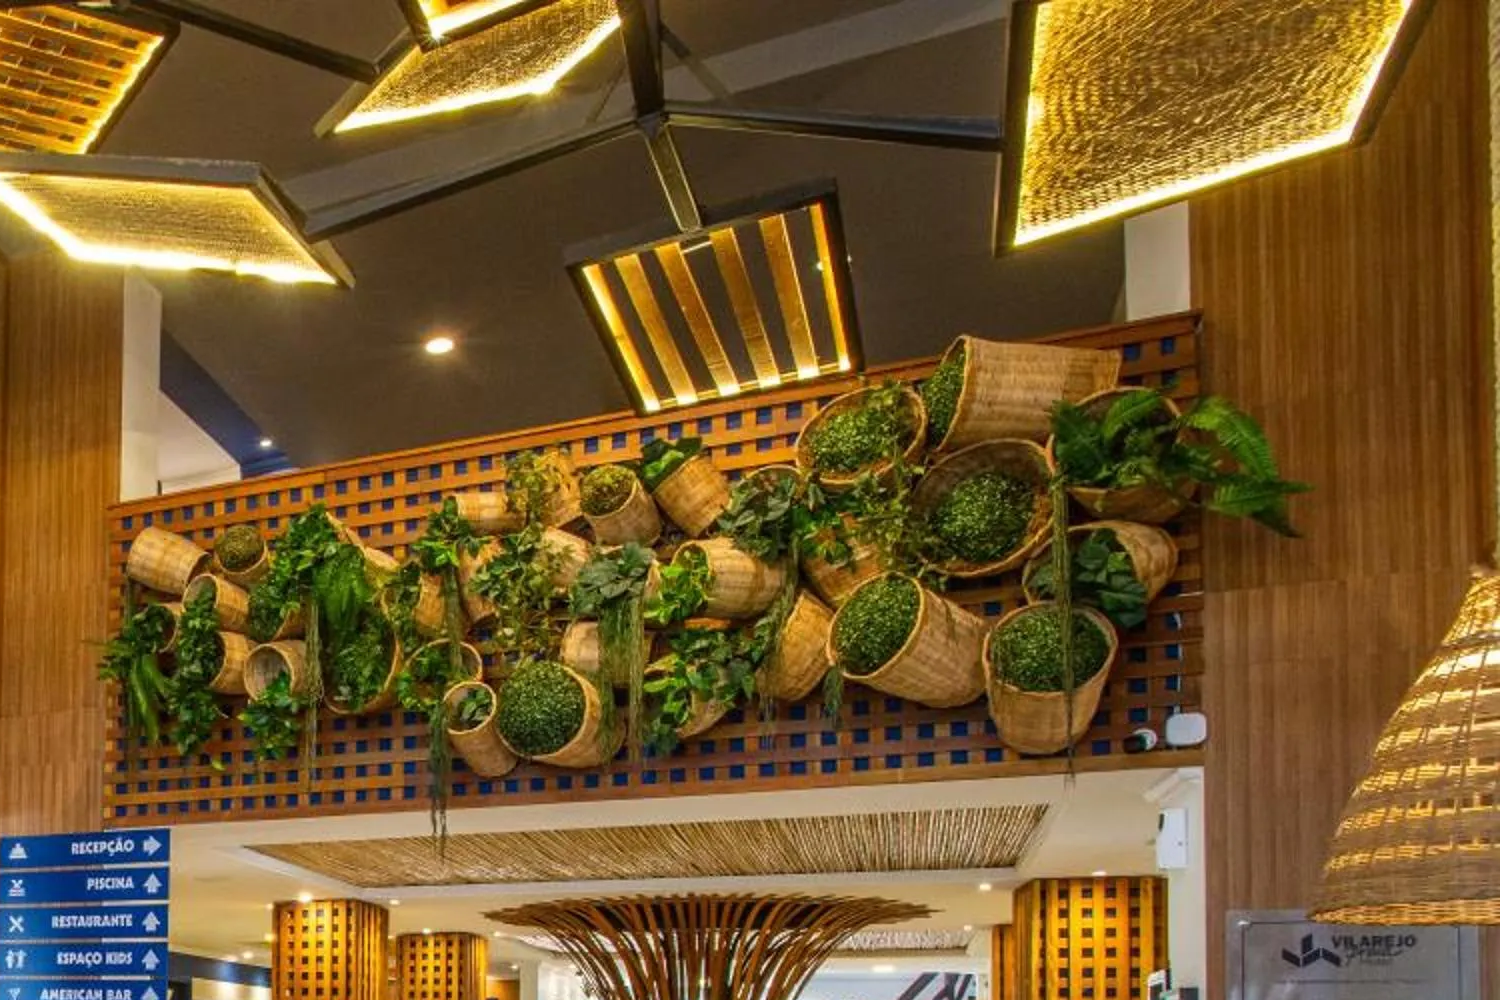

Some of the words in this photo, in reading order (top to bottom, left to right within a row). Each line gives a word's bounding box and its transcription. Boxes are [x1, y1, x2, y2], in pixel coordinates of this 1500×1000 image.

[71, 836, 134, 855] RECEPÇÃO
[87, 876, 134, 890] PISCINA
[52, 914, 132, 928] RESTAURANTE
[1331, 934, 1416, 949] VILAREJO
[57, 952, 102, 967] ESPAÇO
[105, 952, 133, 964] KIDS
[40, 989, 102, 1000] AMERICAN
[106, 989, 132, 1000] BAR
